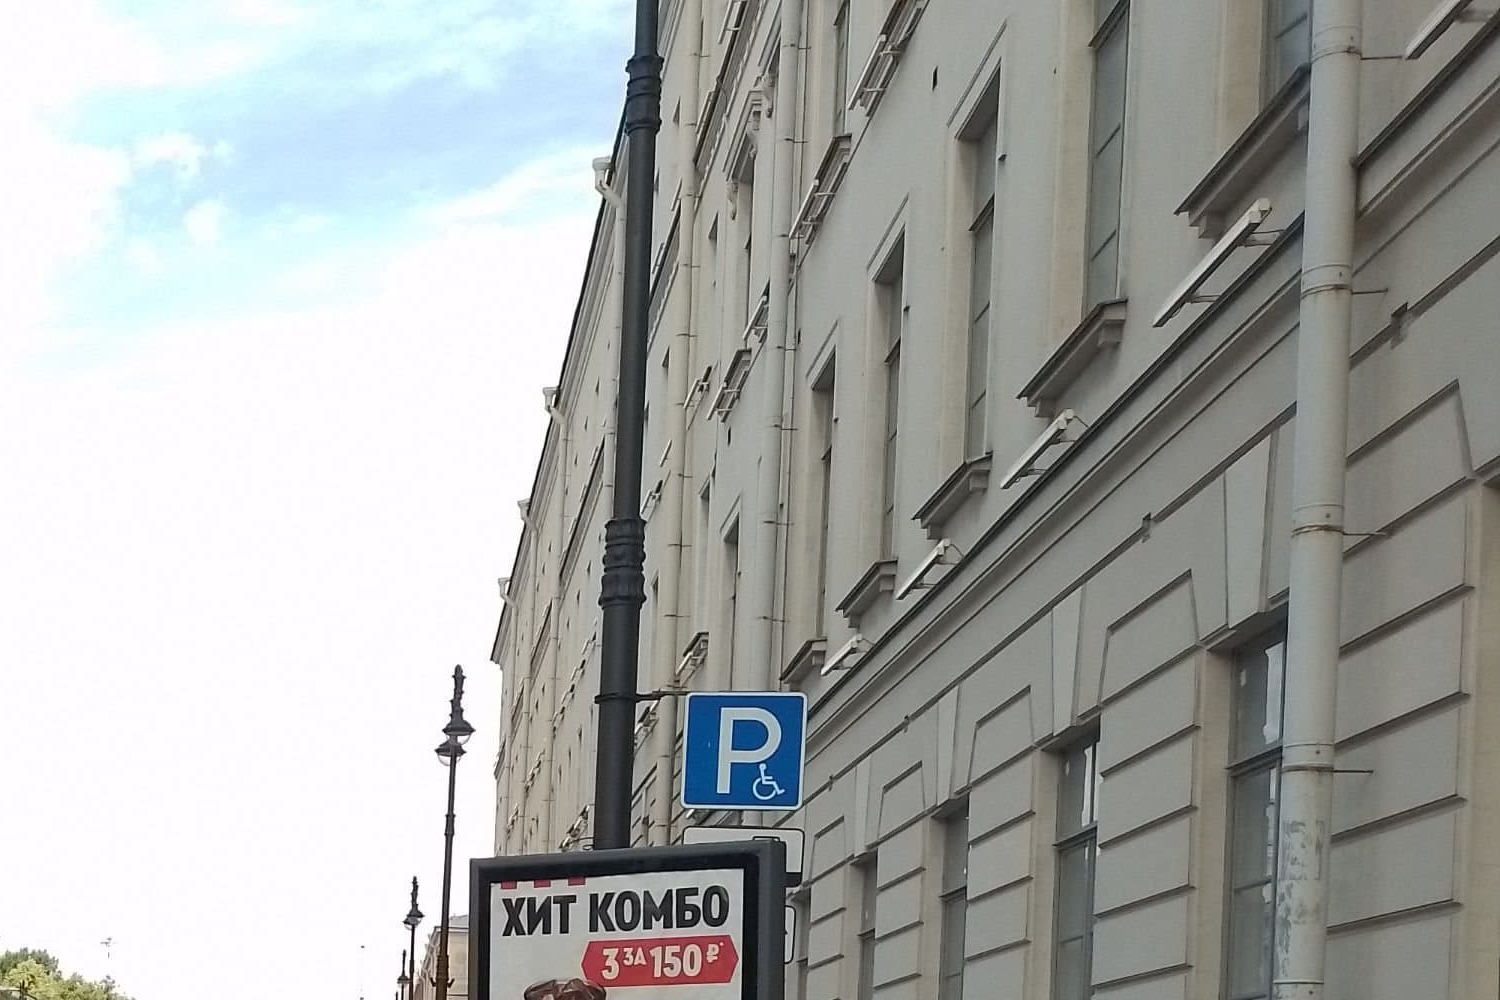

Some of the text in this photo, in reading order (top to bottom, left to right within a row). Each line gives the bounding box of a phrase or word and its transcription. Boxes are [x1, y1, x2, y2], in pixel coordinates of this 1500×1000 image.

[716, 706, 783, 795] P
[501, 885, 730, 937] ХИТ КОМБО
